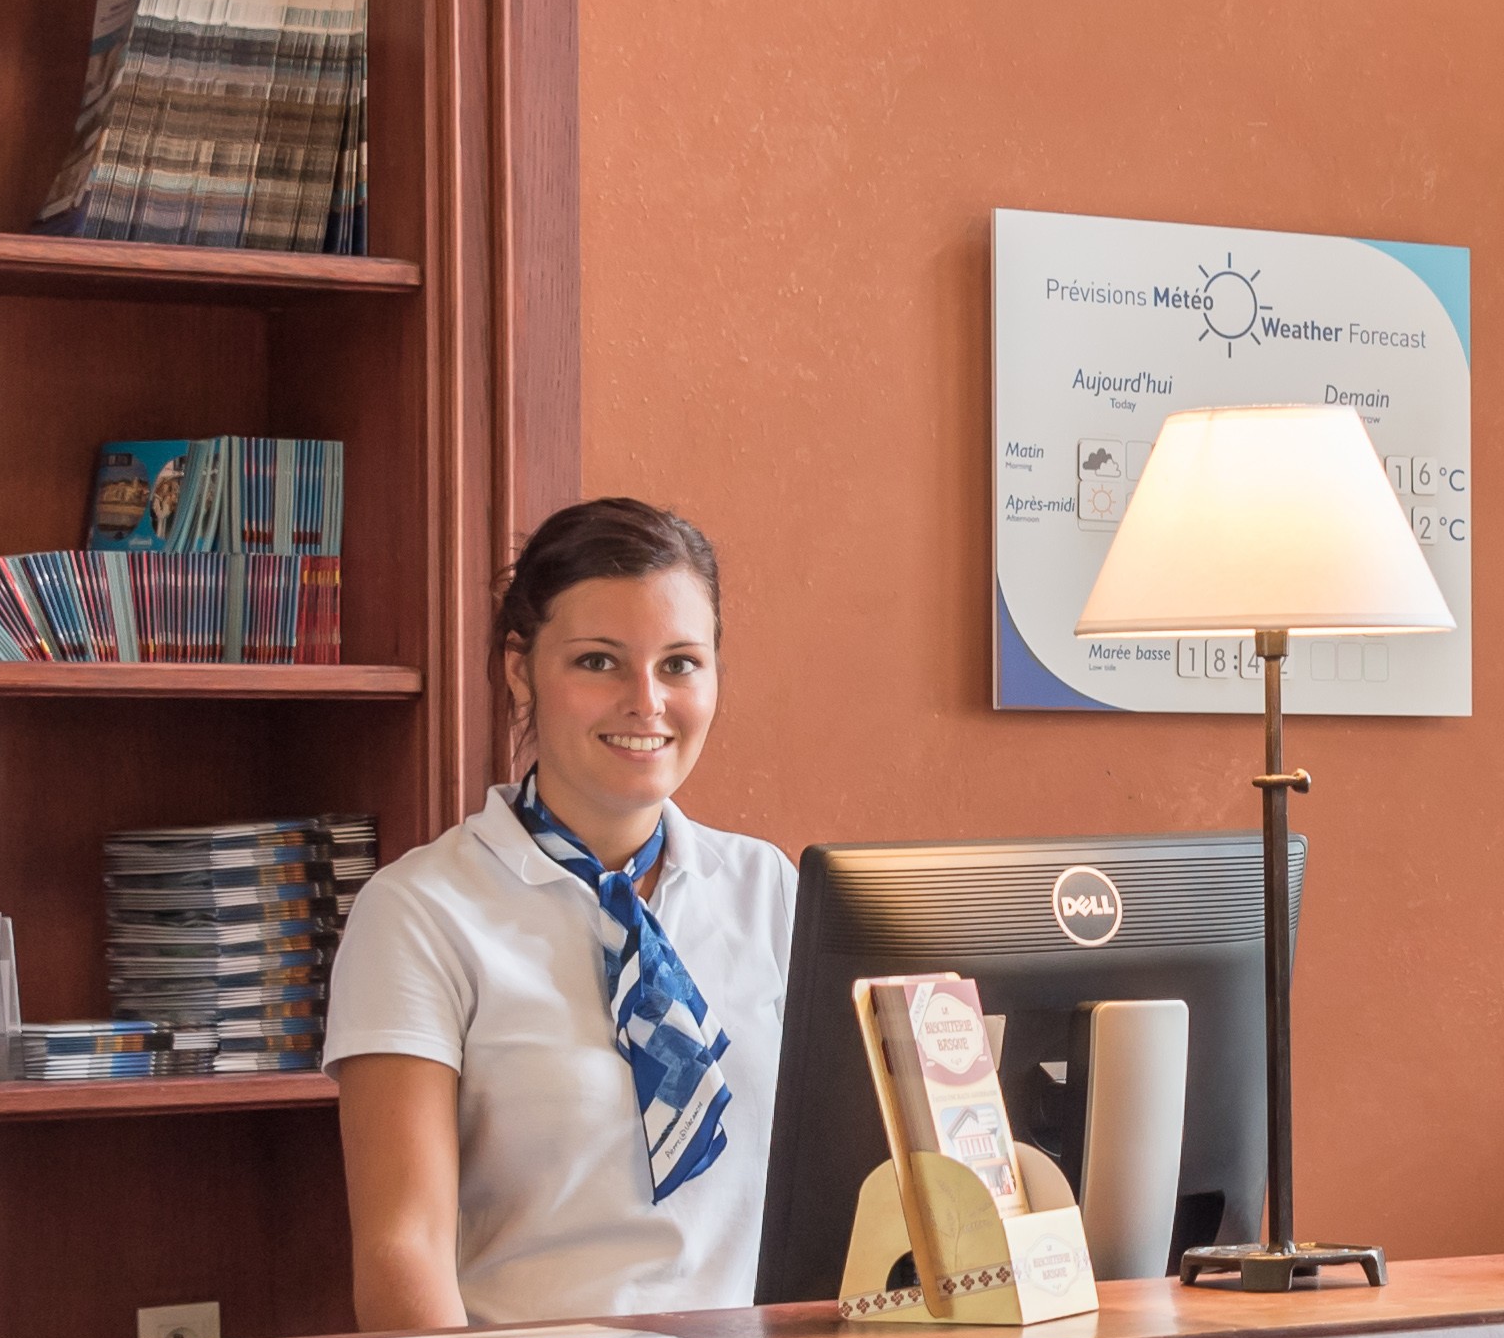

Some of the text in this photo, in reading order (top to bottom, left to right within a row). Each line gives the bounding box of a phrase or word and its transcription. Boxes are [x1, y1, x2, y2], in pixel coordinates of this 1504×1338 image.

[1046, 278, 1214, 311] Prévisions Météo
[1261, 316, 1427, 349] Weather Forecast
[1072, 368, 1174, 397] Aujourd'hui
[1110, 398, 1137, 412] Today
[1324, 384, 1390, 408] Demain
[1005, 441, 1044, 459] Matin
[1005, 494, 1076, 514] Après-midi
[1088, 643, 1131, 660] Marée
[1135, 645, 1171, 661] basse
[1060, 894, 1115, 918] DELL
